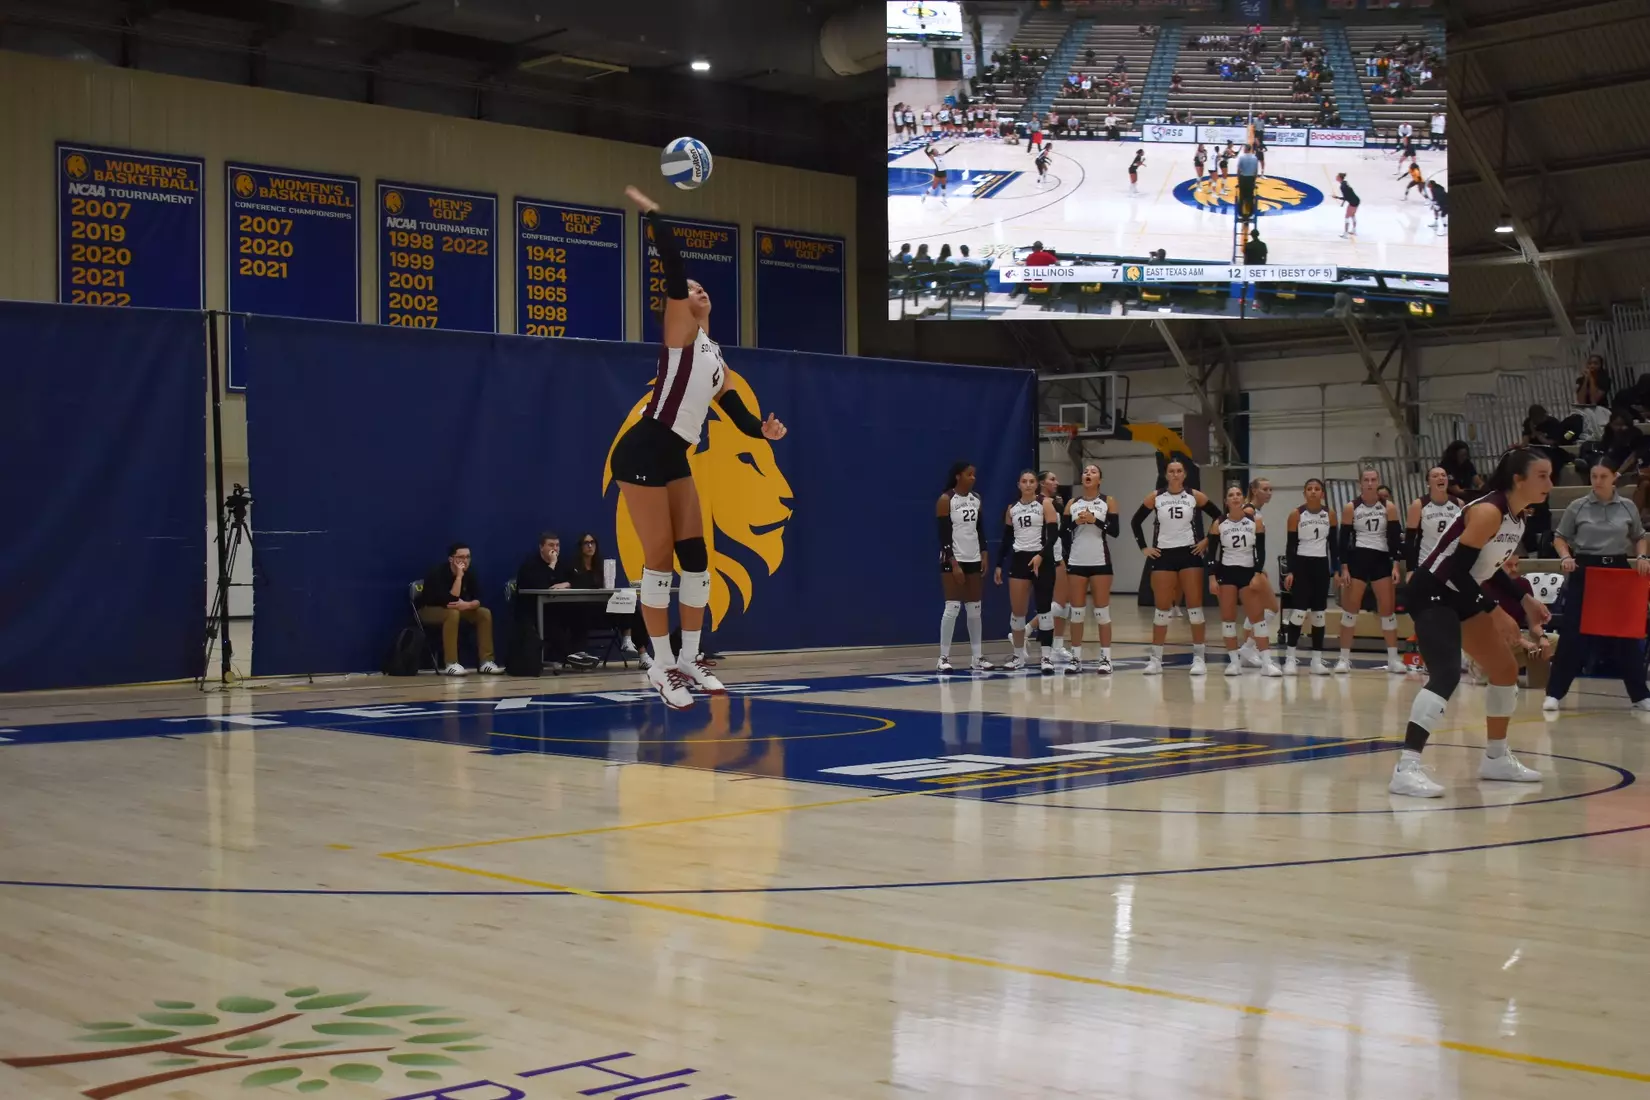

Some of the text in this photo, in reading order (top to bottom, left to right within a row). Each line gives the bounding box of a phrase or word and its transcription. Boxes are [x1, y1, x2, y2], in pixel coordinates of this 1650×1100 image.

[104, 159, 188, 180] WOMEN'S
[690, 148, 702, 178] molten
[93, 169, 199, 192] BASKETBALL
[269, 177, 344, 196] WOMEN'S
[68, 182, 194, 205] NCAA TOURNAMENT
[259, 187, 355, 208] BASKETBALL
[71, 198, 131, 220] 2007
[235, 201, 352, 220] CONFERENCE CHAMPIONSHIPS
[428, 197, 473, 213] MEN'S
[433, 208, 469, 221] GOLF
[561, 211, 601, 226] MEN'S
[71, 221, 126, 242] 2019
[239, 215, 293, 236] 2007
[386, 217, 489, 237] NCAA TOURNAMENT
[565, 222, 598, 235] GOLF
[672, 226, 729, 242] WOMEN'S
[239, 237, 293, 258] 2020
[389, 231, 488, 256] 1998 2022
[521, 232, 618, 249] CONFERENCE CHAMPIONSHIPS
[686, 237, 716, 249] GOLF
[784, 238, 834, 253] WOMEN'S
[71, 244, 131, 265] 2020
[389, 251, 435, 271] 1999
[526, 245, 567, 264] 1942
[680, 249, 733, 263] OURNAMENT
[796, 249, 823, 261] GOLF
[239, 259, 288, 279] 2021
[526, 265, 567, 283] 1964
[760, 258, 840, 273] CONFERENCE CHAMPIONSHIPS
[1023, 267, 1074, 278] S ILLINOIS
[1111, 268, 1119, 279] 7
[1146, 268, 1204, 278] EAST TEXAS A&M
[1228, 268, 1241, 279] 12
[1249, 268, 1333, 279] SET 1 (BEST OF 5)
[71, 267, 125, 287] 2021
[389, 272, 433, 291] 2001
[71, 290, 131, 307] 2022
[389, 292, 438, 312] 2002
[526, 284, 567, 303] 1965
[389, 313, 438, 329] 2007
[526, 304, 567, 322] 1998
[526, 324, 566, 338] 2017
[963, 509, 976, 522] 22
[1018, 515, 1031, 528] 18
[1168, 507, 1183, 519] 15
[1313, 528, 1319, 540] 1
[1365, 519, 1380, 532] 17
[1232, 535, 1247, 548] 21
